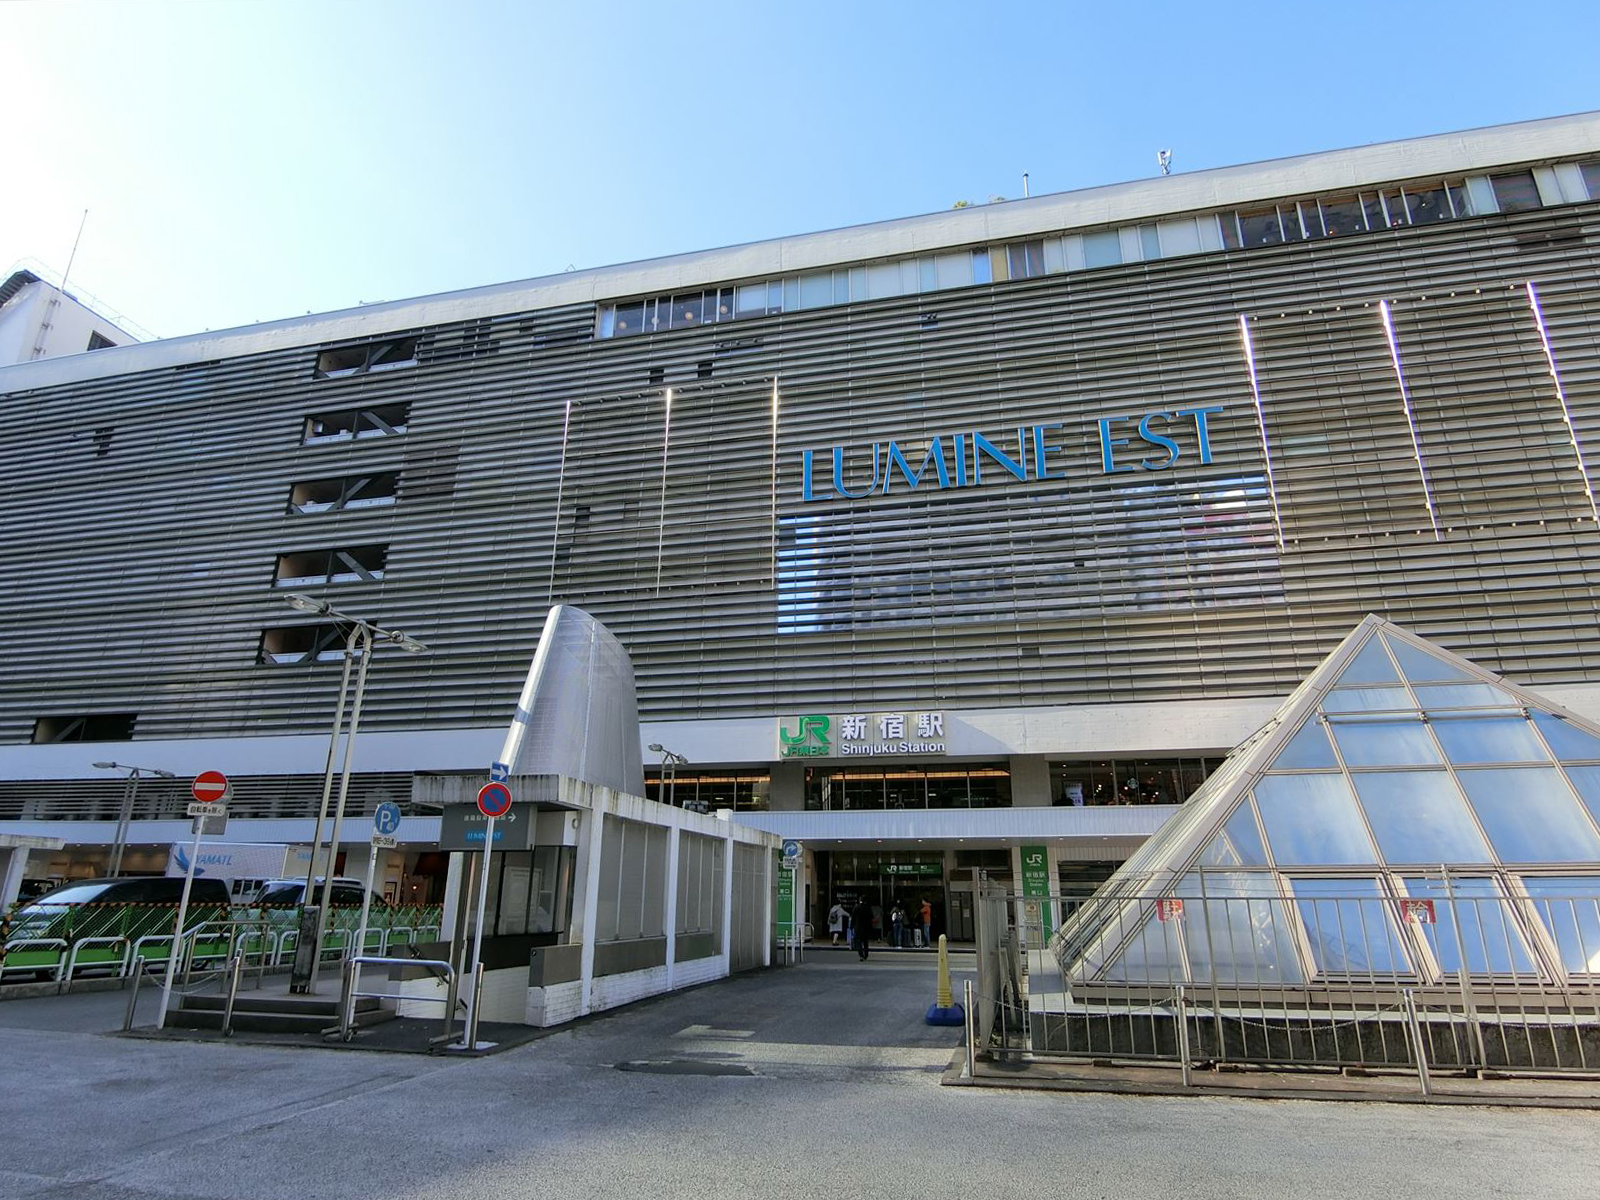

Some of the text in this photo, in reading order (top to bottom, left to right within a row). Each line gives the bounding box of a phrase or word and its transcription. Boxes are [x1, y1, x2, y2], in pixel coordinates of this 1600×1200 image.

[802, 406, 1224, 502] LUMINE EST
[780, 715, 830, 744] JR
[841, 712, 944, 740] 新宿駅
[841, 740, 945, 756] Shinjuku Station
[380, 810, 391, 831] P
[1026, 854, 1043, 864] JR
